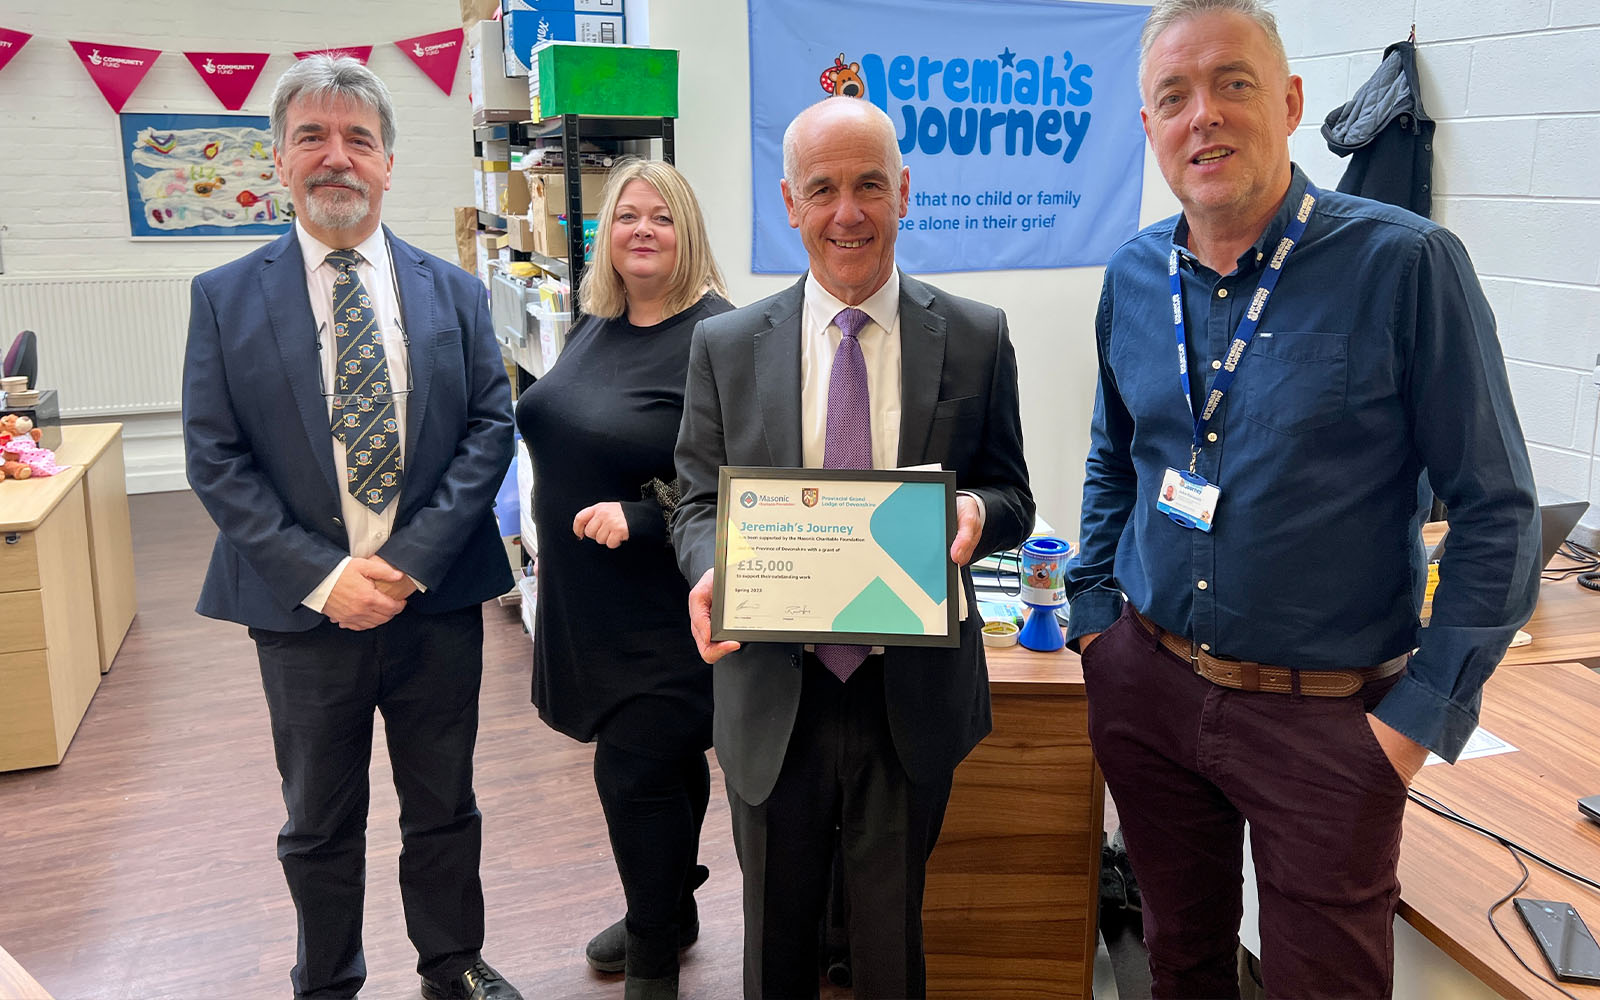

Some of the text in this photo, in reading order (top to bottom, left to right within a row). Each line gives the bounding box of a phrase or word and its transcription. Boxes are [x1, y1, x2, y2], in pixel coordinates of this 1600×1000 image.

[102, 56, 144, 66] COMMUNITY
[861, 49, 1093, 114] Jeremiah's
[897, 105, 1092, 164] Journey
[915, 192, 947, 206] that
[951, 194, 971, 206] no
[976, 191, 1012, 206] child
[1016, 194, 1033, 206] or
[1037, 190, 1081, 208] family
[919, 216, 960, 230] alone
[965, 215, 978, 229] in
[982, 214, 1017, 229] their
[1021, 213, 1057, 232] grief
[759, 494, 790, 502] Masonic
[740, 522, 854, 535] Jeremiah's Journey
[737, 560, 794, 573] £15,000
